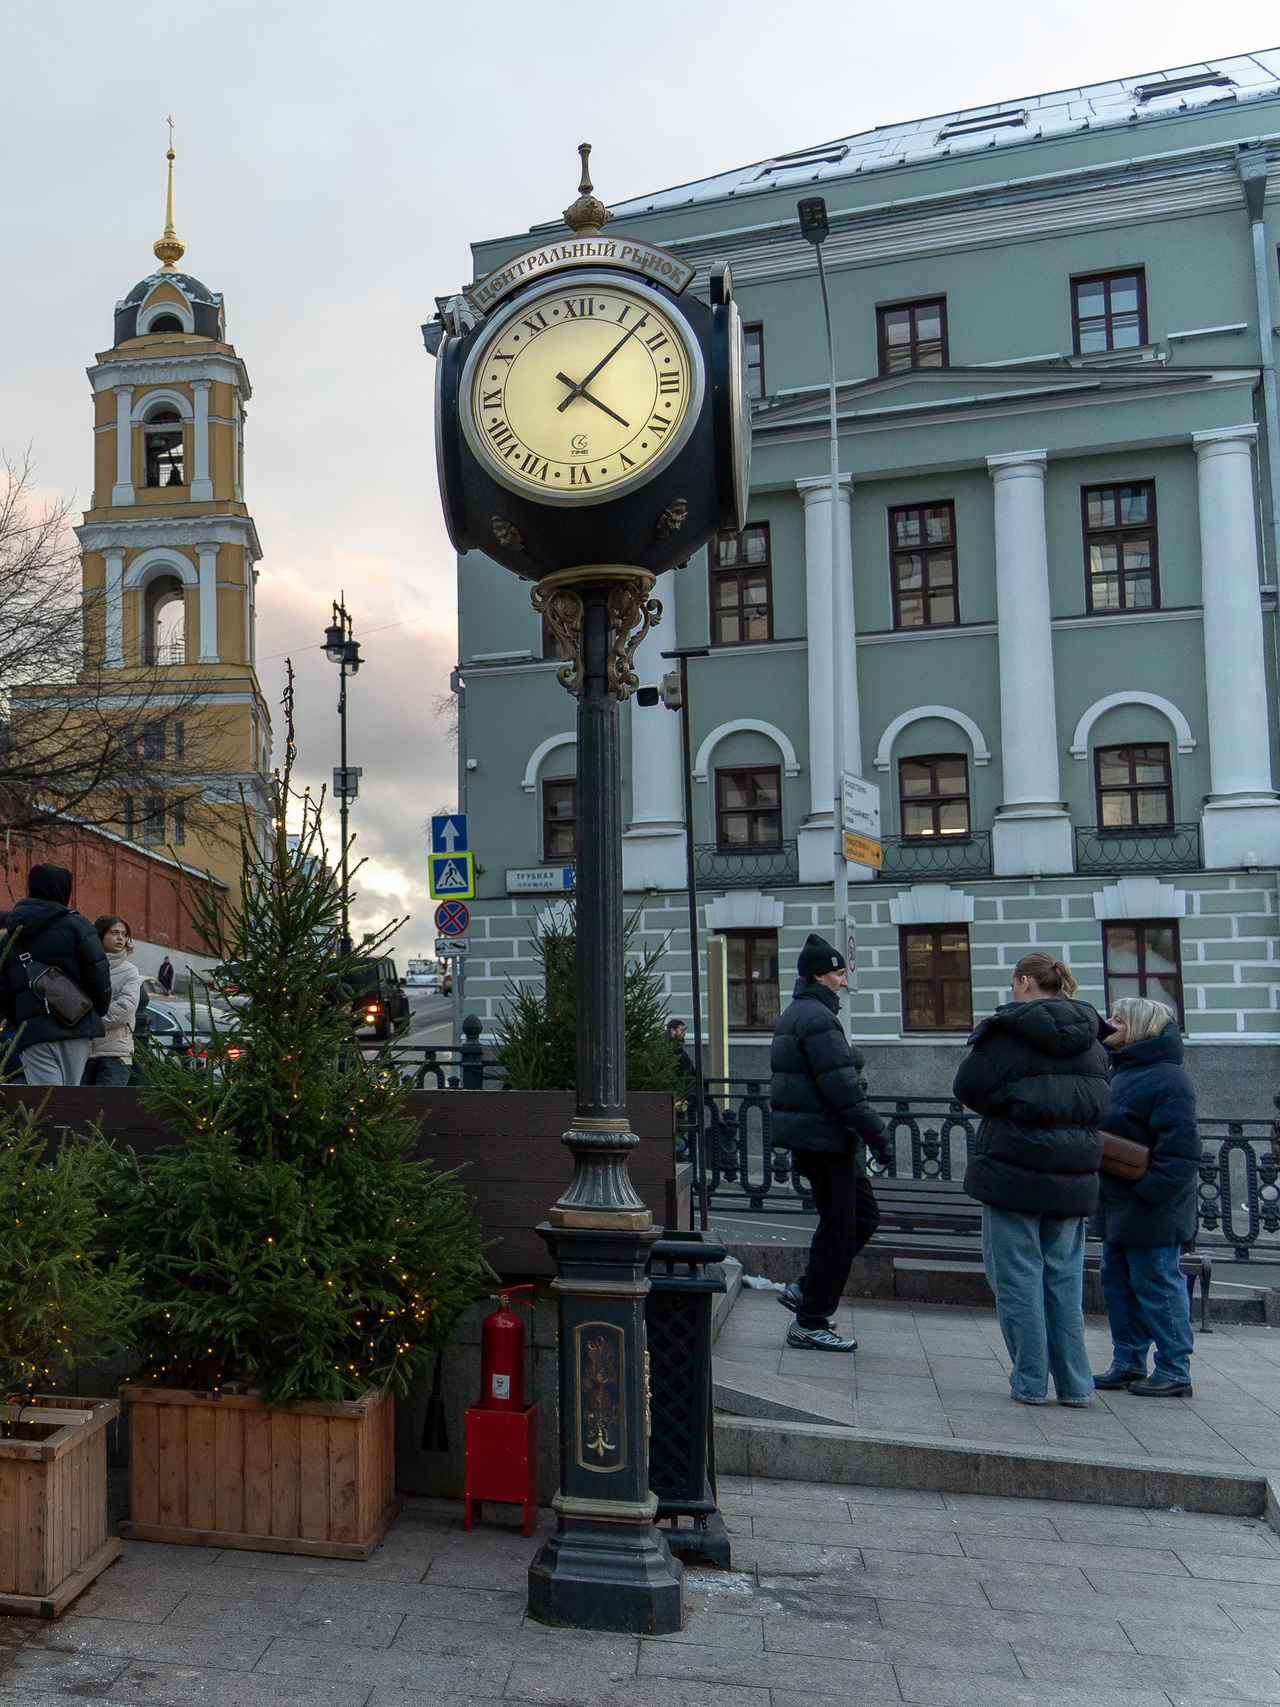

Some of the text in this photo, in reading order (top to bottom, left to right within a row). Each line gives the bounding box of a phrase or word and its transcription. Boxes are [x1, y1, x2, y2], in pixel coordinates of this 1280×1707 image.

[476, 240, 686, 304] ЦЕНТРАЛЬНЫЙ РЫНОК
[516, 872, 554, 880] ТРУБНАЯ
